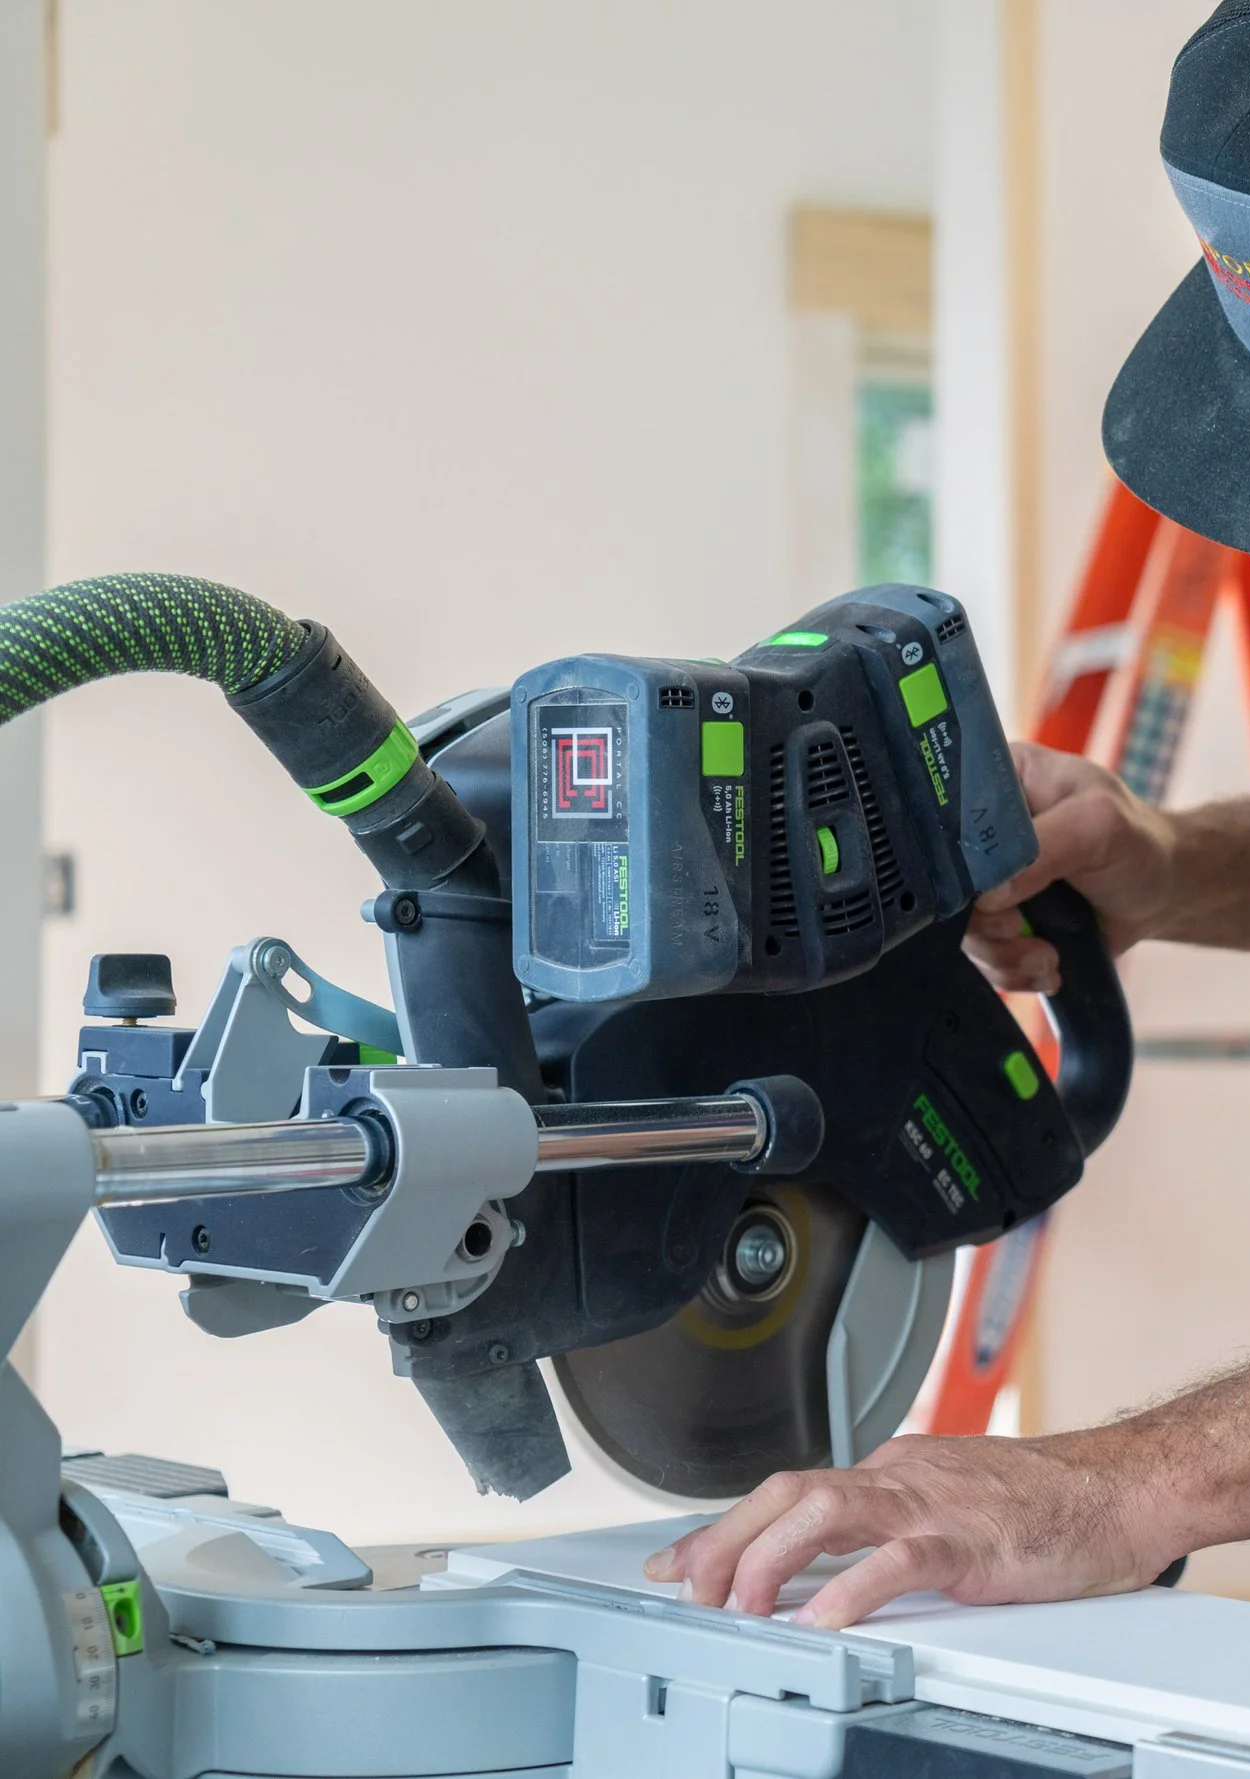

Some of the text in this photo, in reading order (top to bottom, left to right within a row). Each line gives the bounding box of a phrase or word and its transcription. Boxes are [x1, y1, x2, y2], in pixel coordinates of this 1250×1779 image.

[920, 732, 949, 807] FESTOOL
[725, 800, 732, 814] Ah
[735, 785, 745, 867] FESTOOL
[969, 807, 999, 856] 18 V
[618, 855, 629, 936] FESTOOL
[703, 885, 720, 943] 18 V
[913, 1093, 981, 1202] FESTOOL
[81, 1616, 93, 1630] 10
[86, 1645, 98, 1660] 20
[89, 1675, 100, 1691] 30
[88, 1704, 99, 1721] 40
[930, 1717, 1110, 1761] FESTOOL
